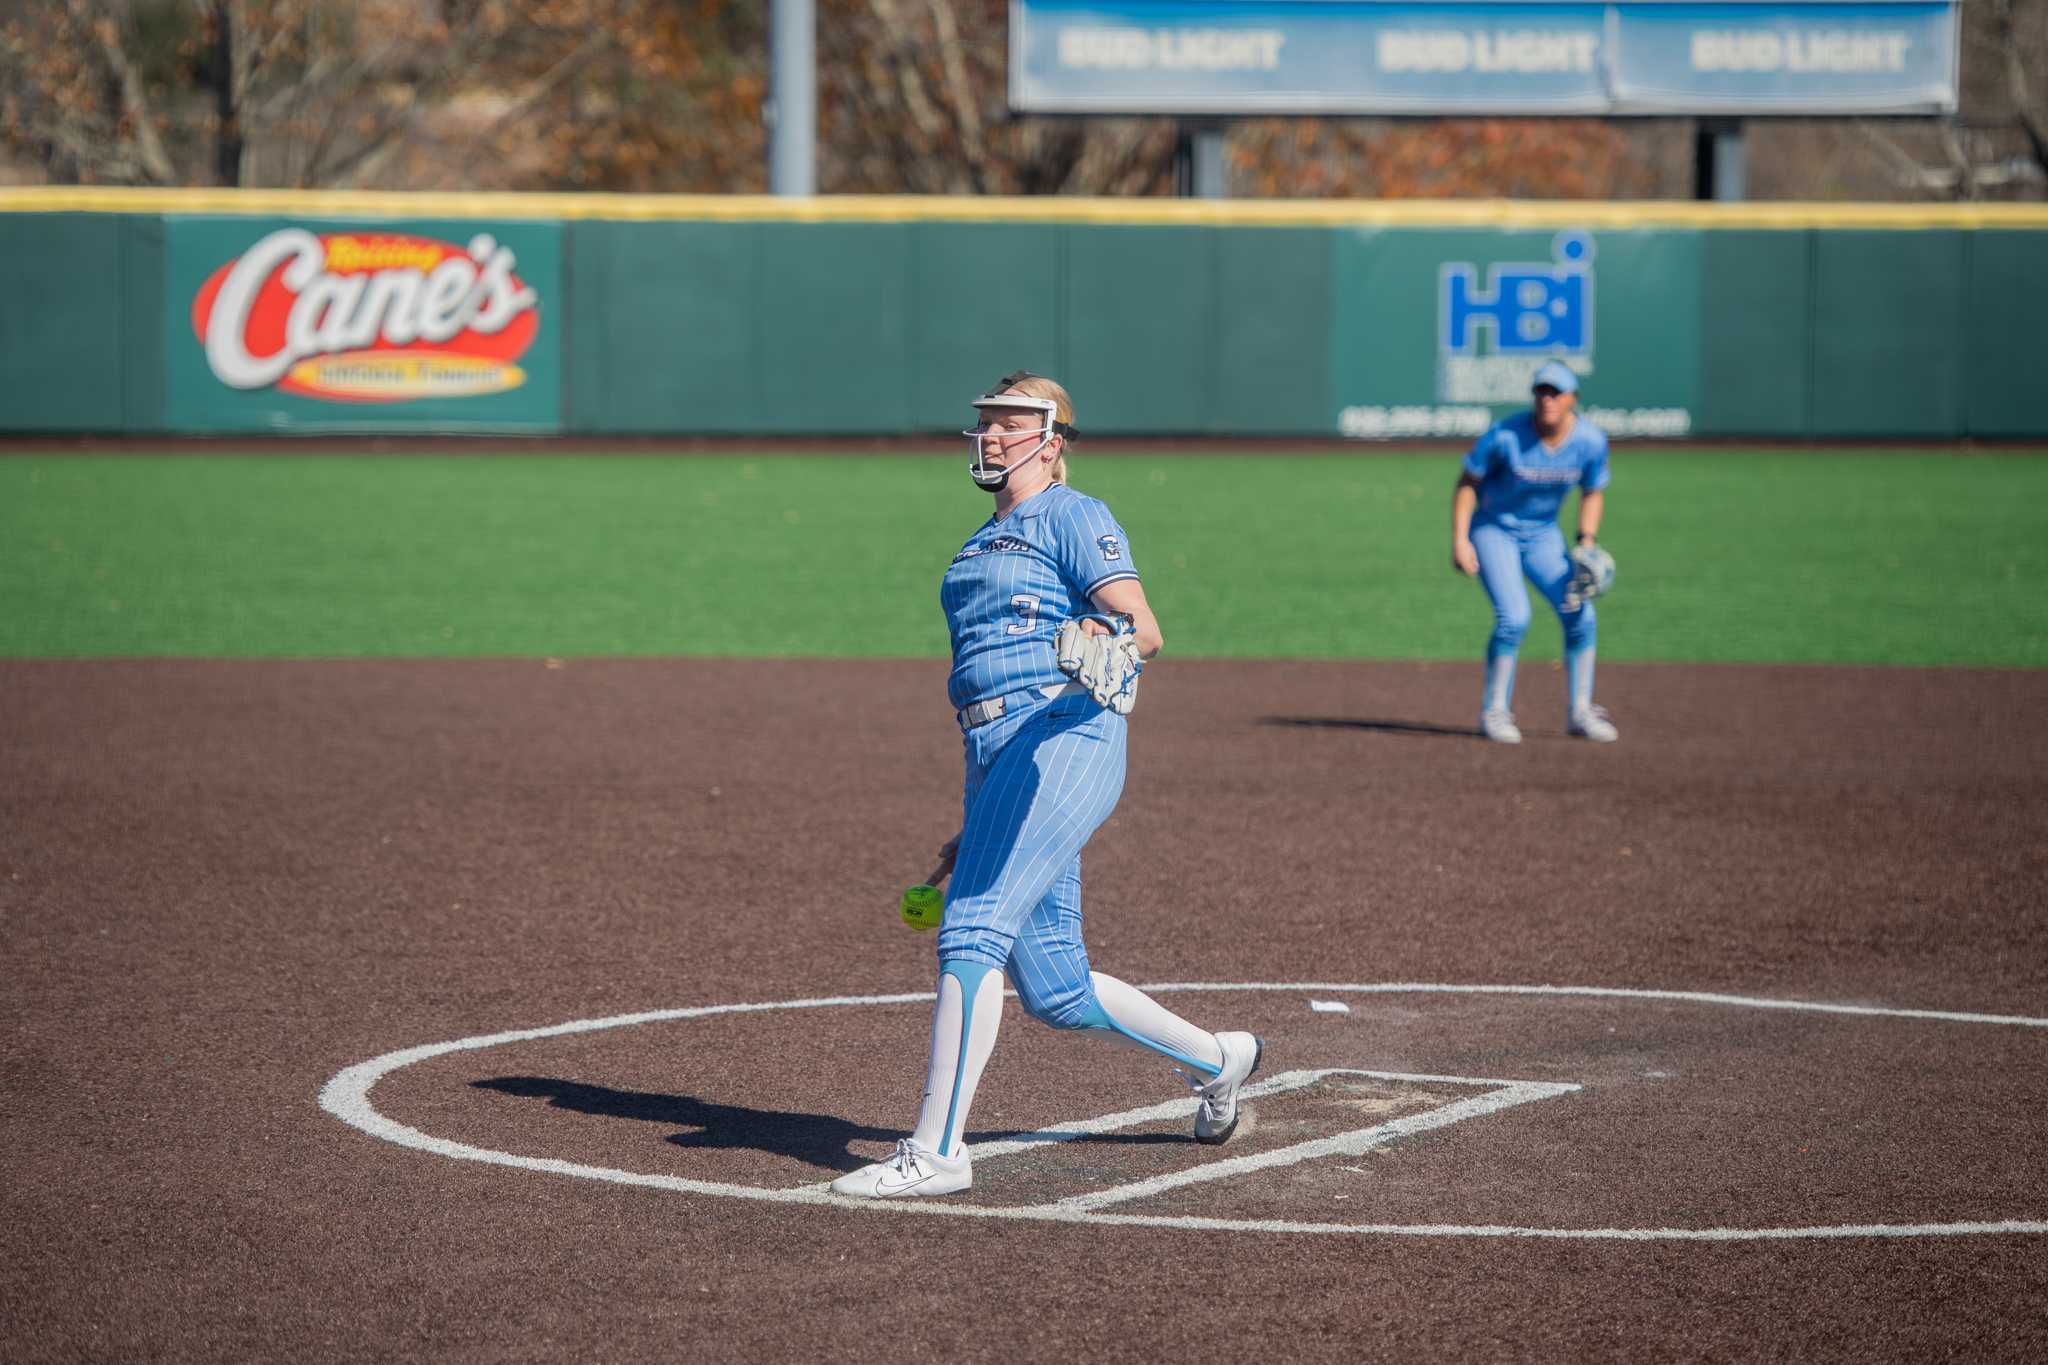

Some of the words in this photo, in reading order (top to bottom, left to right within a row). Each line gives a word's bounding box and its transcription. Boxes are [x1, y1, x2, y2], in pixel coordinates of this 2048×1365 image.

[1059, 27, 1151, 69] BUD
[1157, 28, 1284, 70] LIGHT
[1378, 30, 1469, 72] BUD
[1474, 31, 1598, 72] LIGHT
[1691, 30, 1780, 71] BUD
[1786, 31, 1909, 72] LIGHT
[205, 228, 537, 390] Cane's
[1006, 593, 1041, 636] 3
